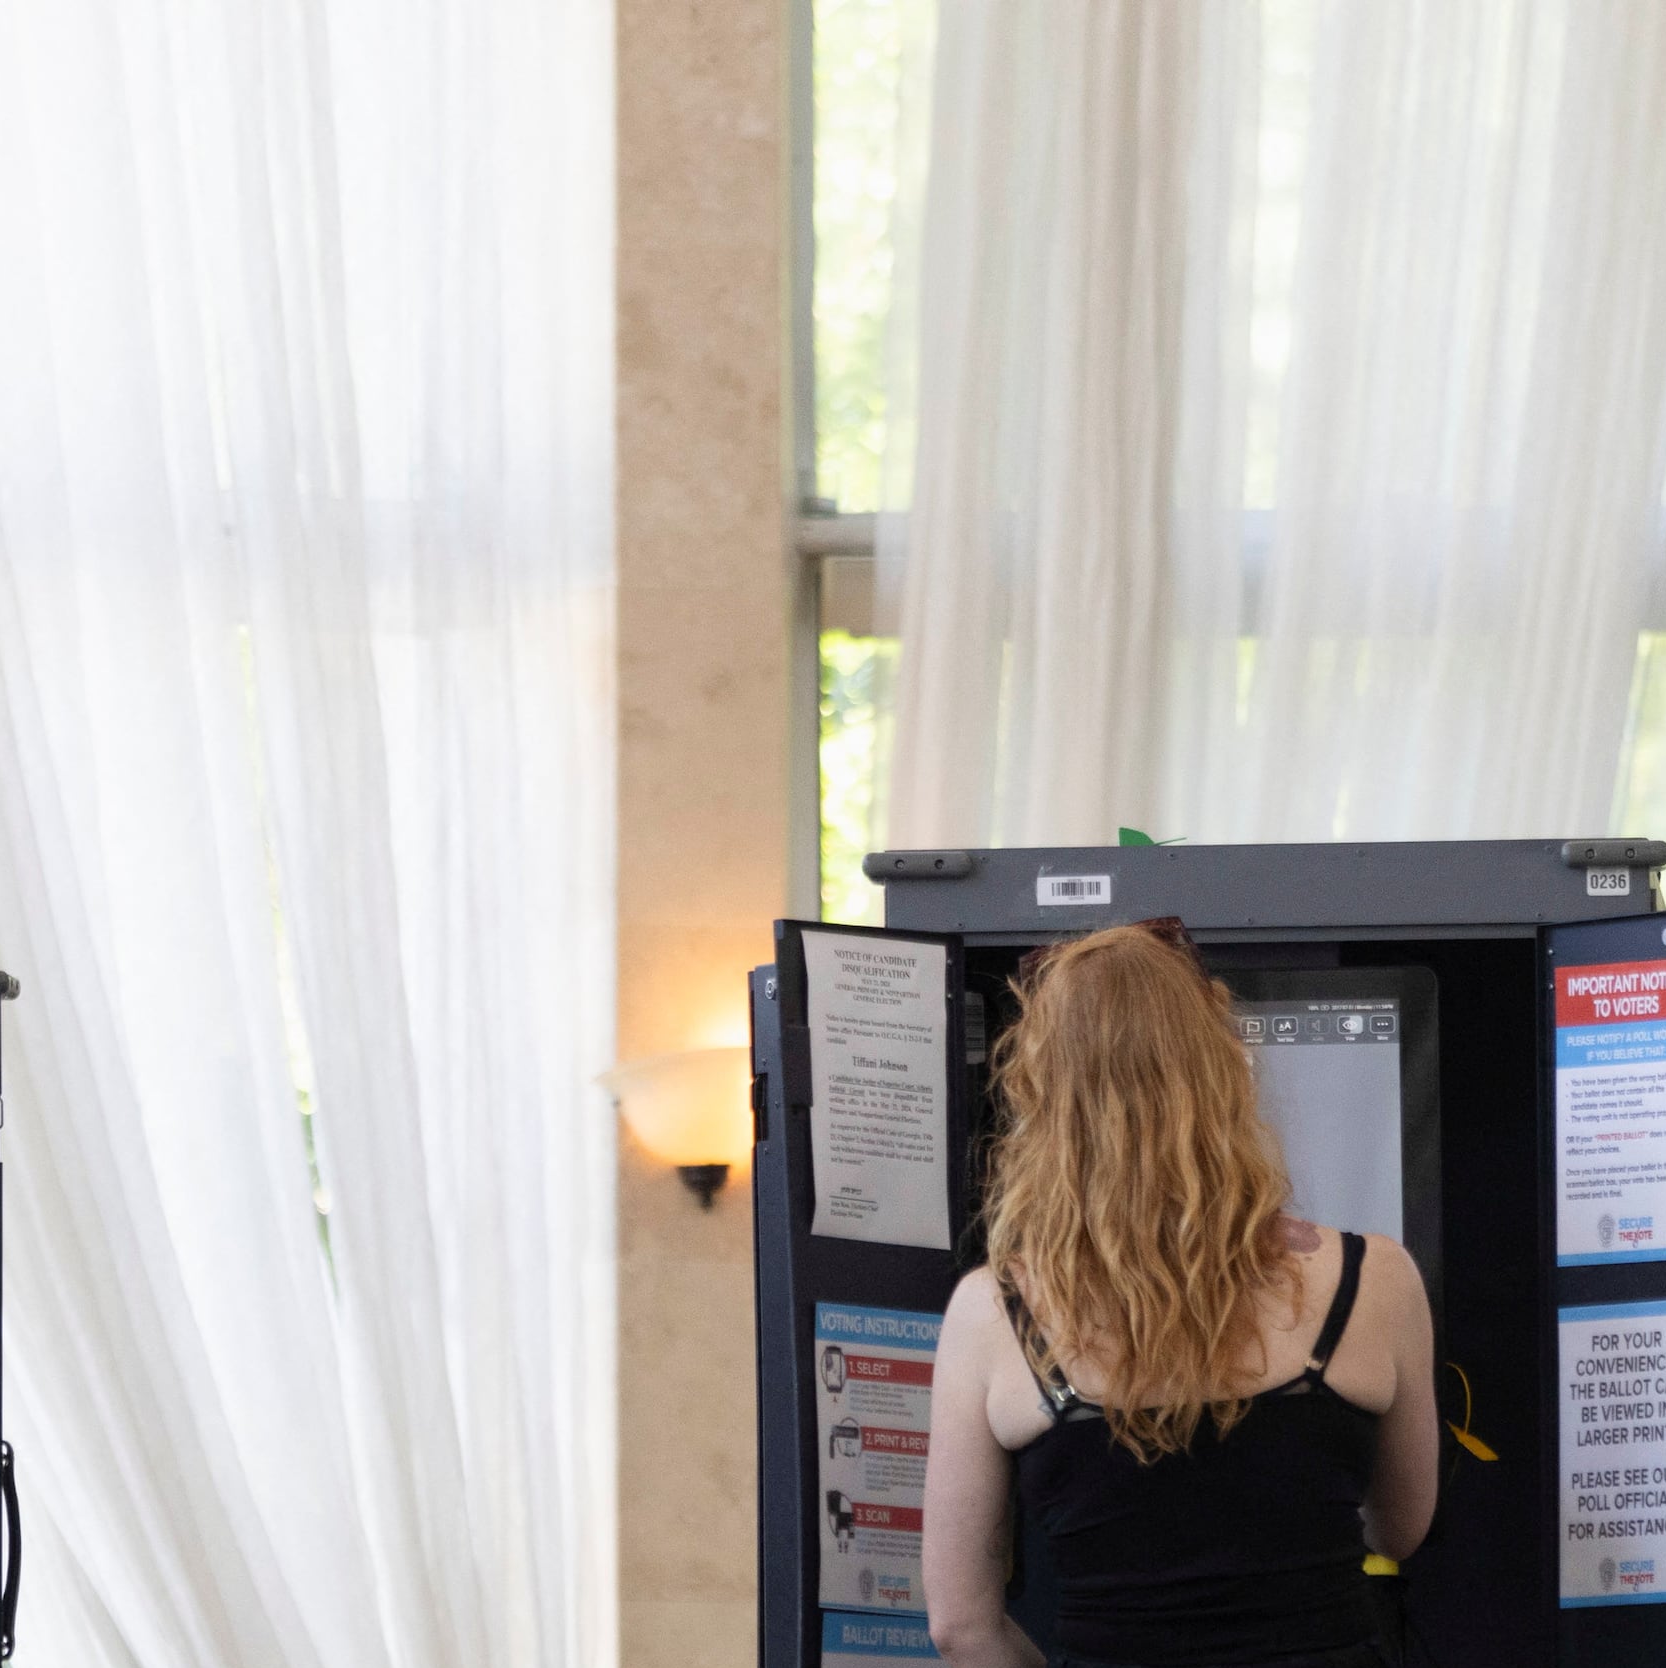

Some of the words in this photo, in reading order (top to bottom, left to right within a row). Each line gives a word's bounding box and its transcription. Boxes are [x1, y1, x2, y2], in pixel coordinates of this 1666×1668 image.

[1590, 874, 1627, 889] 0236
[1568, 974, 1637, 996] IMPORTANT
[1594, 999, 1610, 1017] TO
[1614, 995, 1659, 1016] VOTERS
[819, 1312, 862, 1334] VOTING
[1592, 1334, 1619, 1351] FOR
[1625, 1332, 1662, 1350] YOUR
[1570, 1383, 1595, 1399] THE
[1599, 1379, 1649, 1398] BALLOT
[1581, 1406, 1597, 1422] BE
[1602, 1403, 1654, 1421] VIEWED
[1577, 1428, 1628, 1447] LARGER
[1572, 1471, 1620, 1489] PLEASE
[1624, 1469, 1648, 1486] SEE
[1578, 1495, 1609, 1512] POLL
[1568, 1523, 1594, 1540] FOR
[843, 1625, 883, 1646] BALLOT
[887, 1628, 929, 1648] REVIEW
